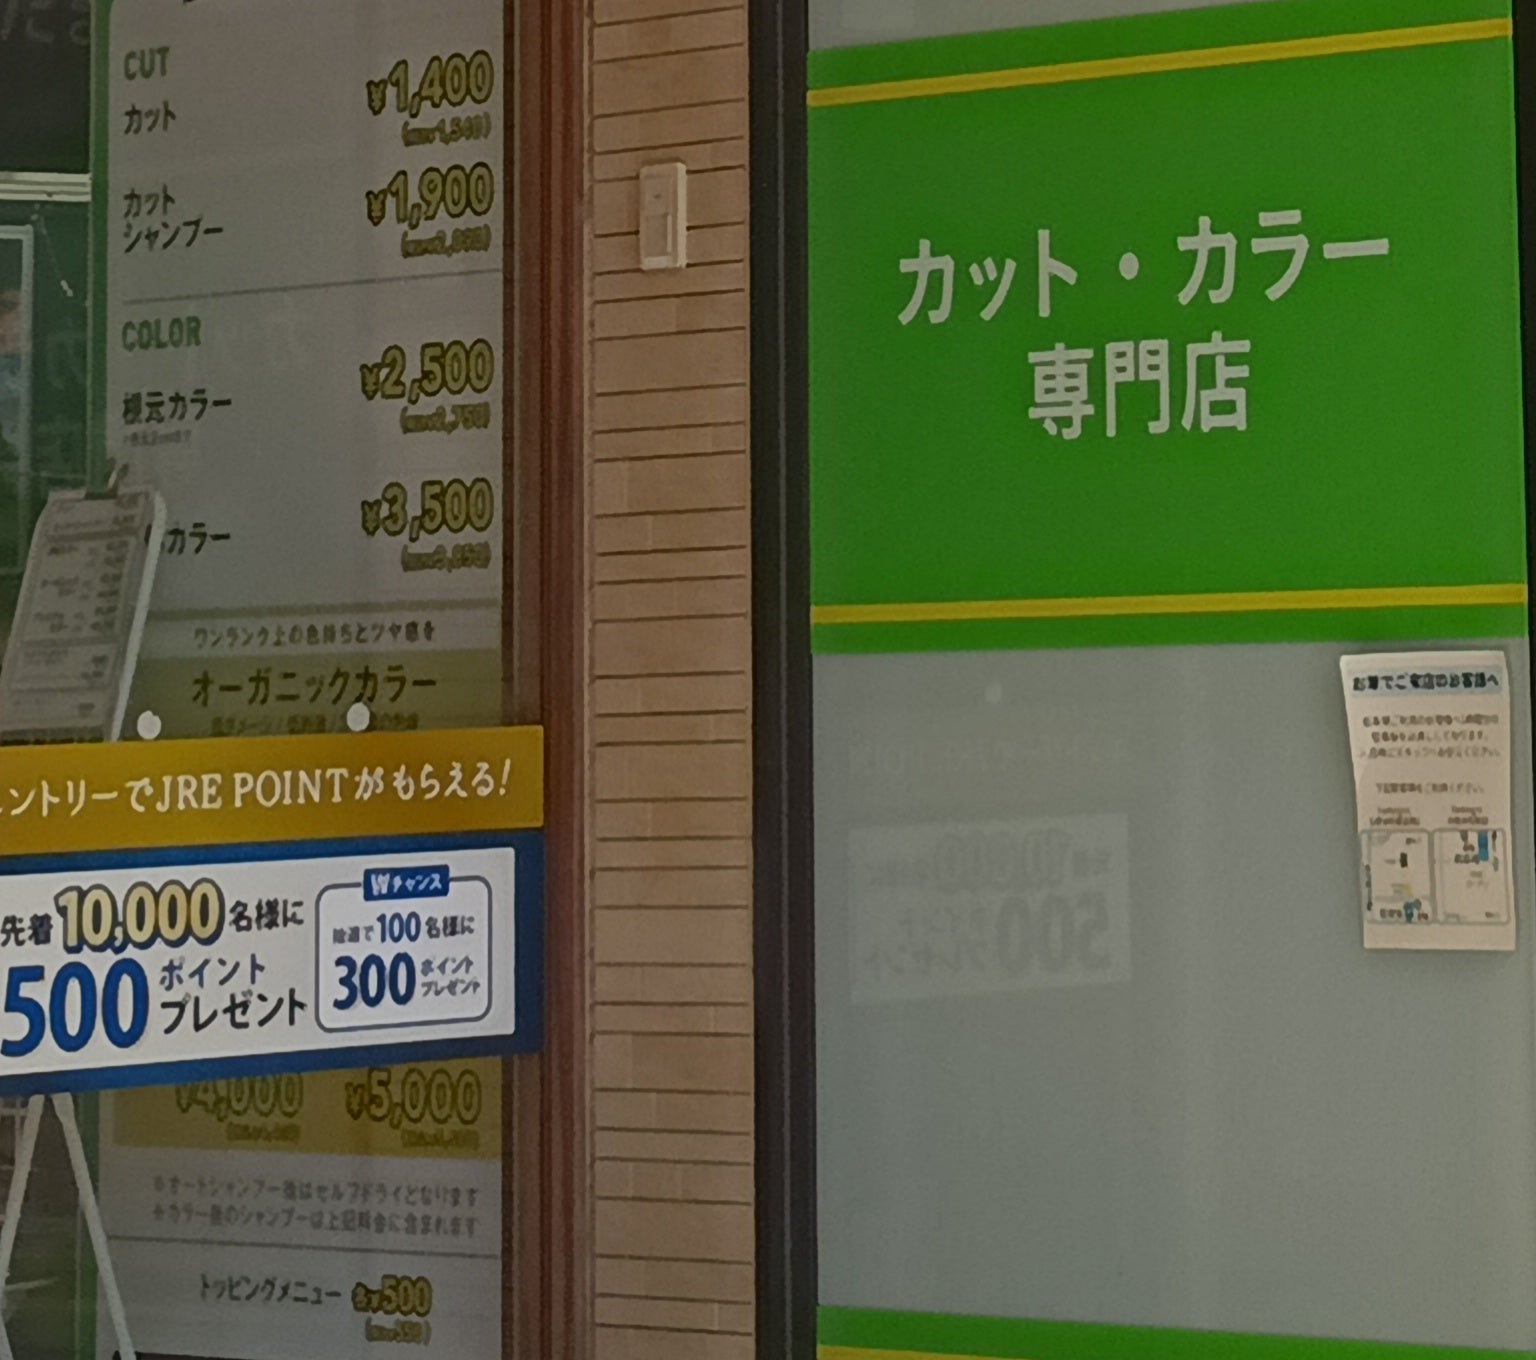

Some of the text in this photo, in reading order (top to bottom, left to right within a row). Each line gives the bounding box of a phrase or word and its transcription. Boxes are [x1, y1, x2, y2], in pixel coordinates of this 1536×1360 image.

[124, 47, 170, 78] CUT
[365, 50, 494, 118] ¥1,400
[124, 103, 177, 135] カット
[123, 186, 176, 219] カット
[365, 162, 494, 229] ¥1,900
[123, 219, 224, 253] シャンプー
[898, 209, 1390, 325] カット・カラー
[122, 317, 201, 351] COLOR
[360, 339, 494, 404] ¥2,500
[1028, 331, 1251, 440] 専門店
[123, 391, 232, 426] 根元カラー
[360, 478, 494, 538] ¥3,500
[145, 522, 231, 555] カラー
[192, 665, 437, 707] オーガニックカラー
[0, 774, 222, 818] ントリーでJRE
[158, 953, 267, 992] ポイント
[333, 952, 416, 1011] 300
[421, 954, 474, 977] ポイント
[421, 976, 481, 997] プレゼント
[0, 958, 149, 1057] 500
[158, 988, 309, 1035] プレゼント
[200, 1273, 342, 1305] トッピングメニュー
